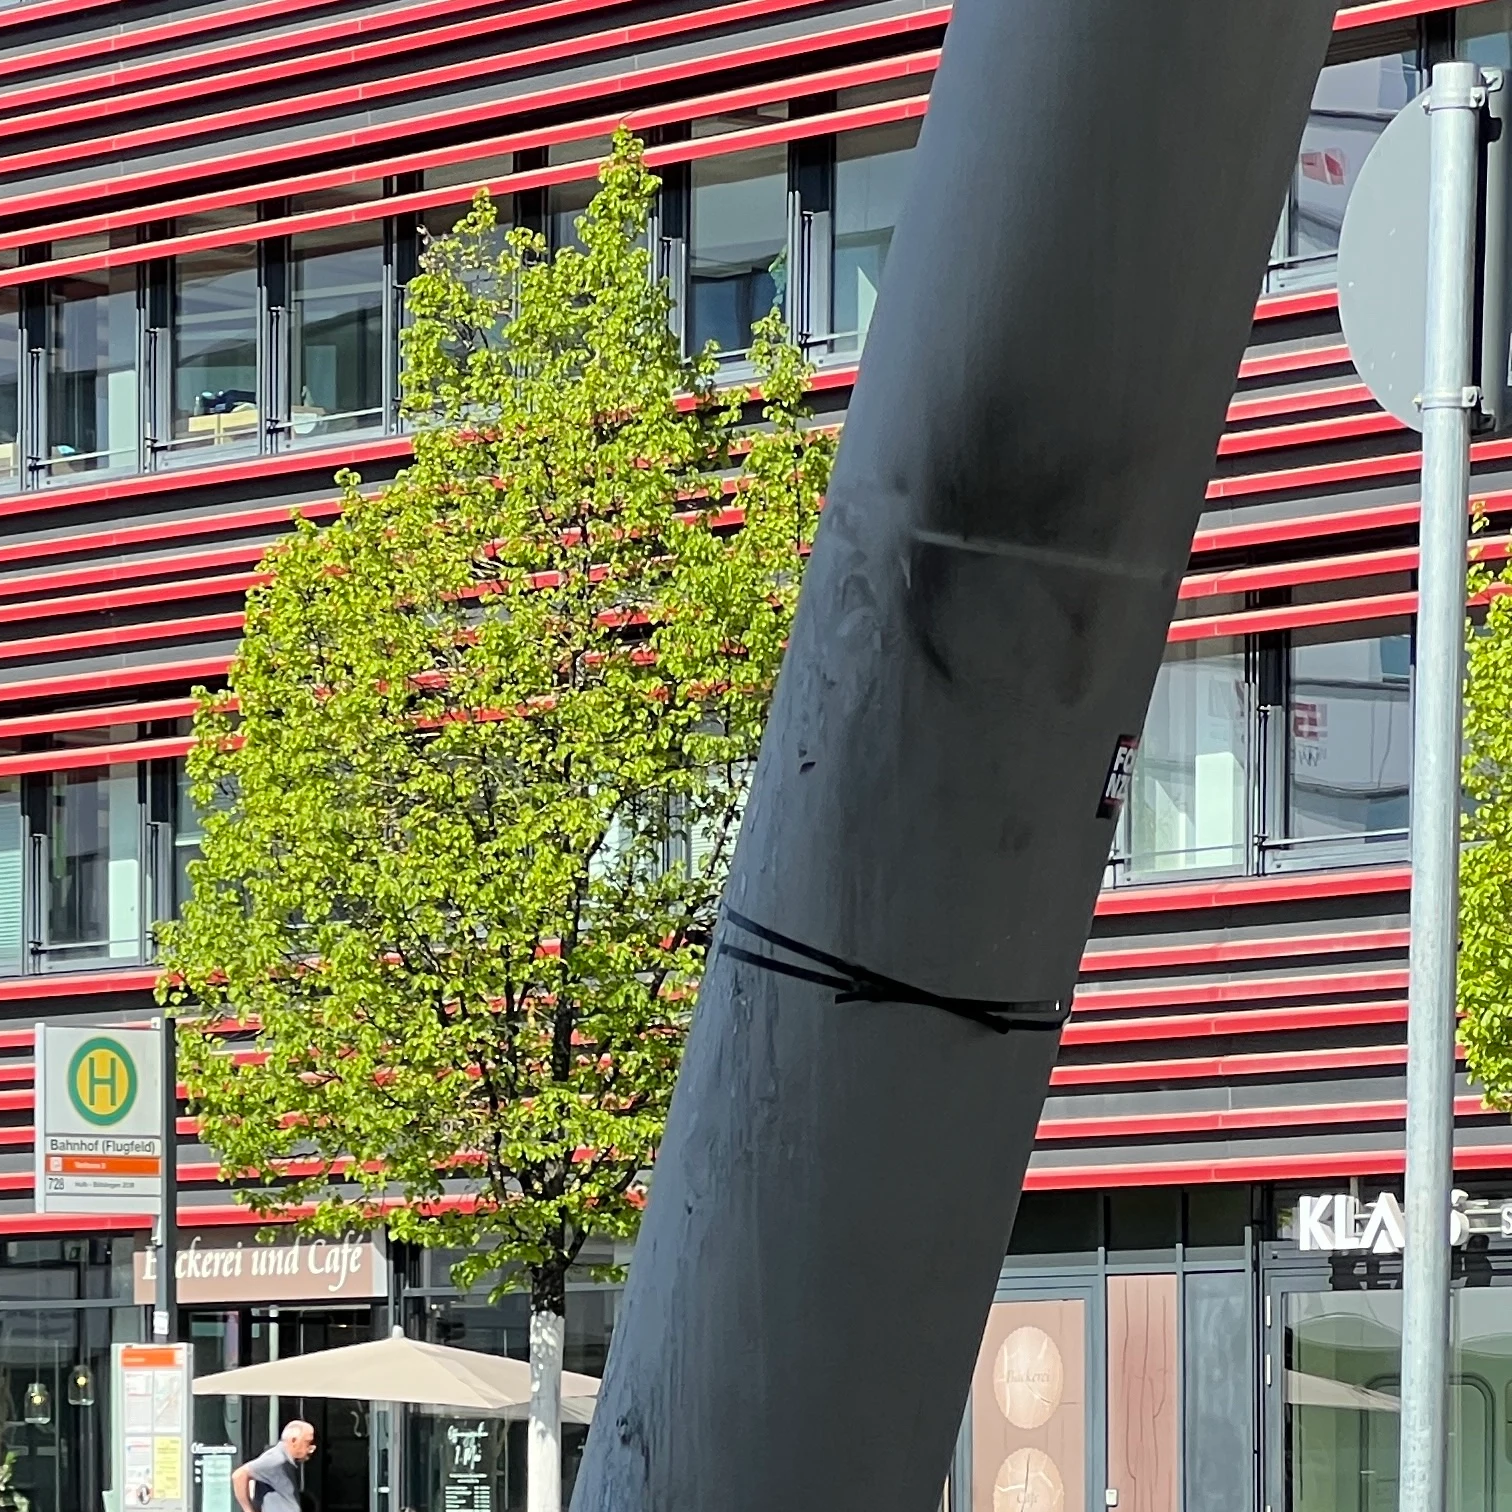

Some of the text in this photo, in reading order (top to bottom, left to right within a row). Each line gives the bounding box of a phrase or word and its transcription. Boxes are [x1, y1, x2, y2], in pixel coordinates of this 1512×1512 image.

[89, 1057, 116, 1106] H
[50, 1138, 156, 1155] Bahnhof (Flugfeld)
[1299, 1188, 1470, 1254] KLA
[142, 1229, 363, 1292] Bckerei und Café
